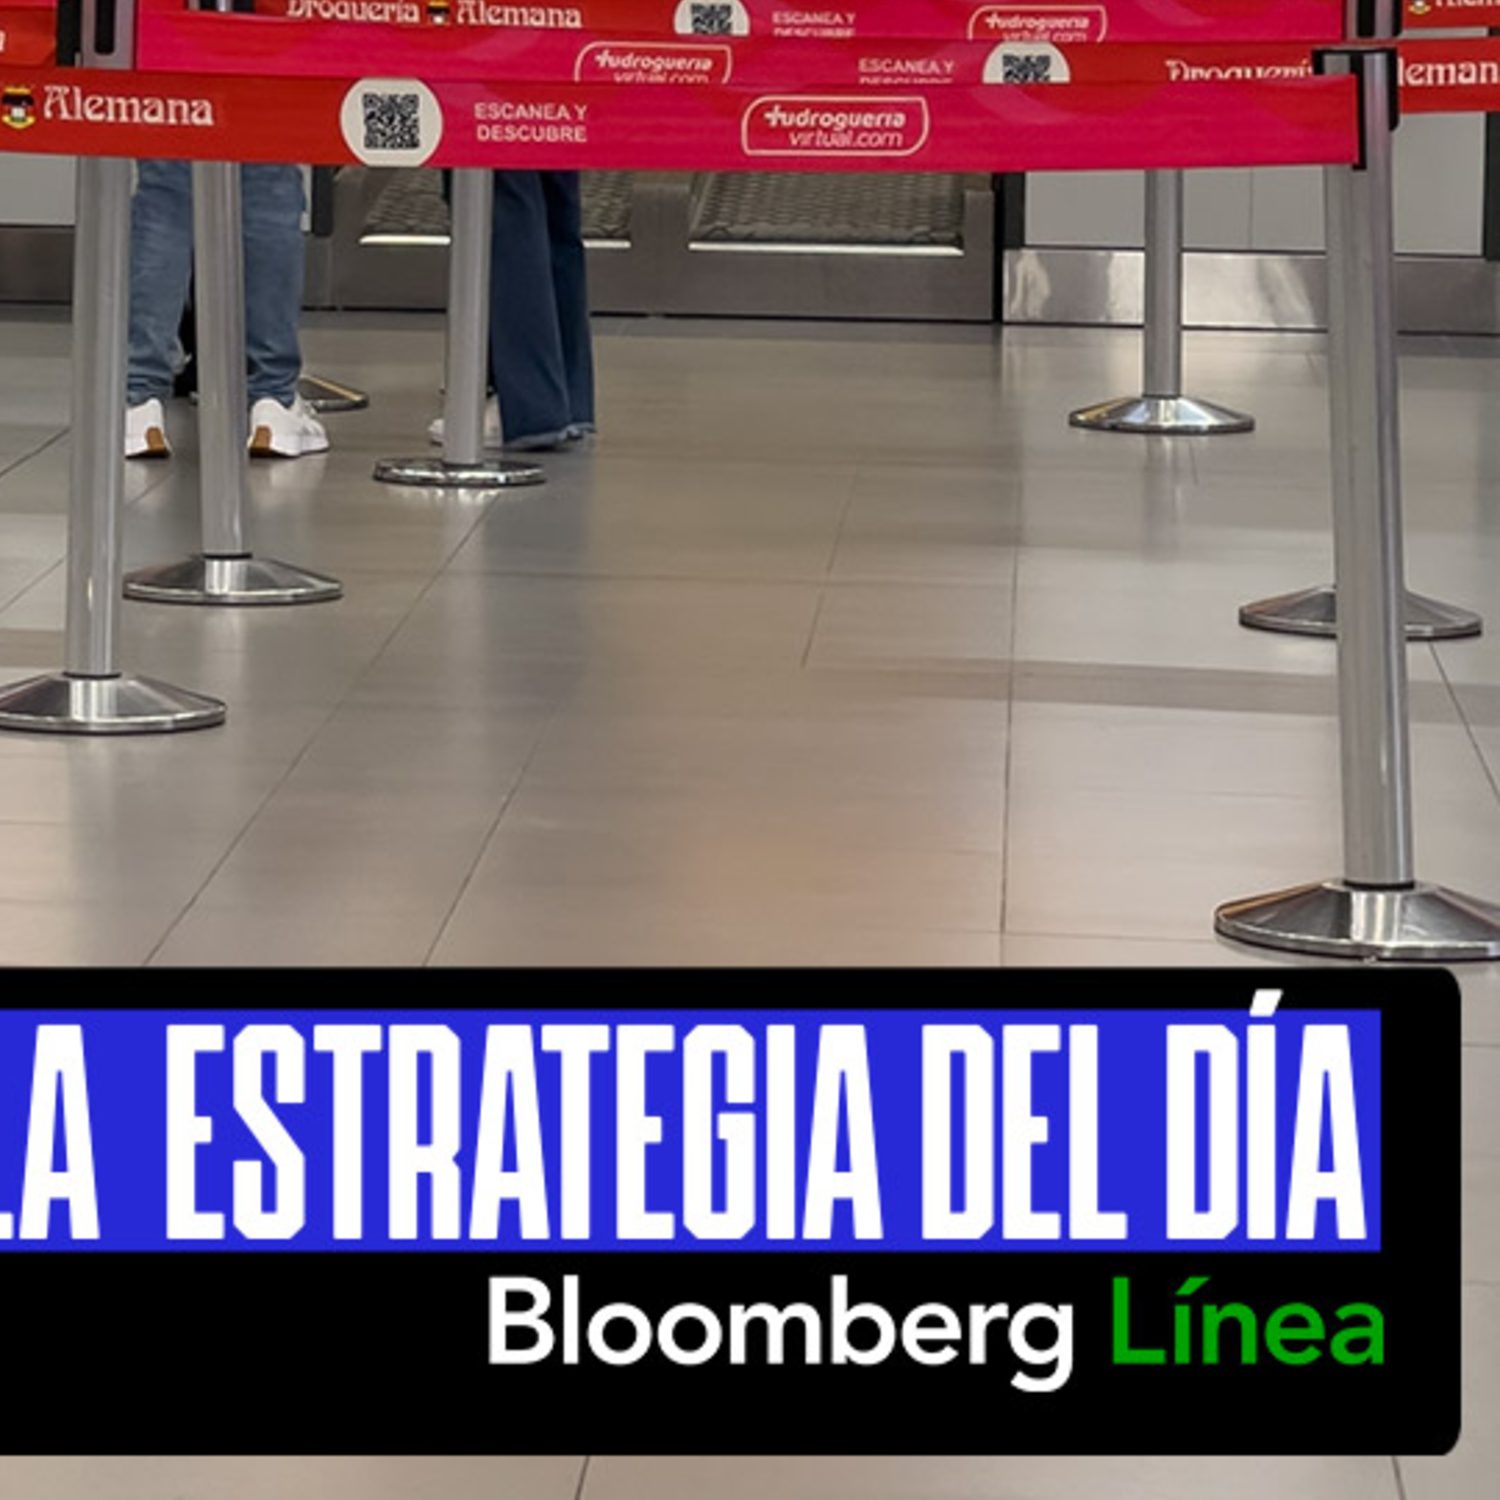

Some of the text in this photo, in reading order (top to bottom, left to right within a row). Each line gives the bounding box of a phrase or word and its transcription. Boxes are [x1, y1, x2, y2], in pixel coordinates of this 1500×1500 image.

[858, 58, 941, 75] ESCANEA
[43, 83, 215, 126] Alemana
[474, 102, 587, 121] ESCANEA Y
[476, 123, 588, 143] DESCUBRE
